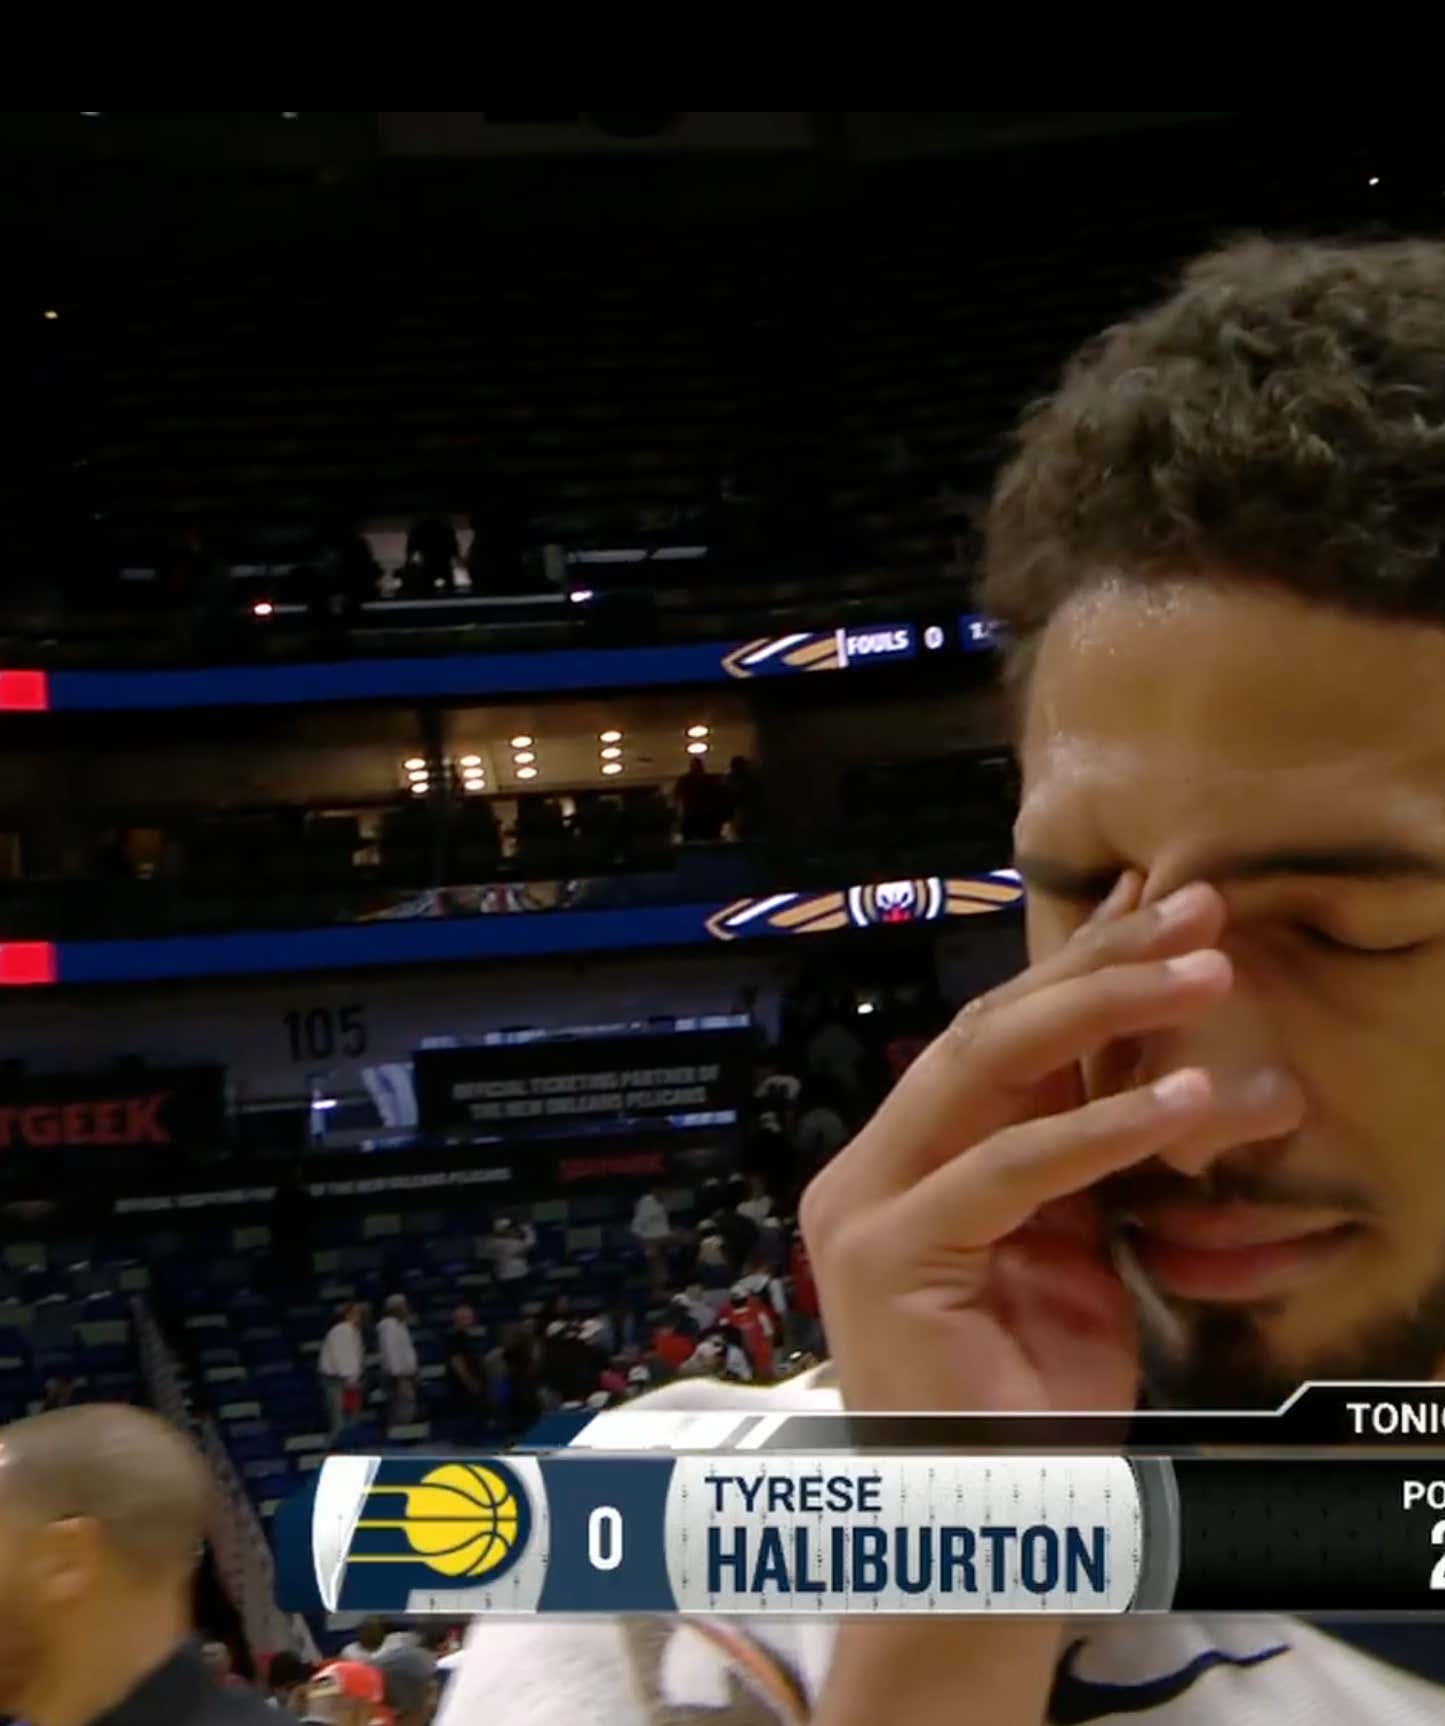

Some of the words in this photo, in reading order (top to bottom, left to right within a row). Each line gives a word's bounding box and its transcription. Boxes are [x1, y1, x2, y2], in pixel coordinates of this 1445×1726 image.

[847, 629, 910, 657] FOULS
[923, 624, 945, 651] 0
[285, 1004, 367, 1062] 105
